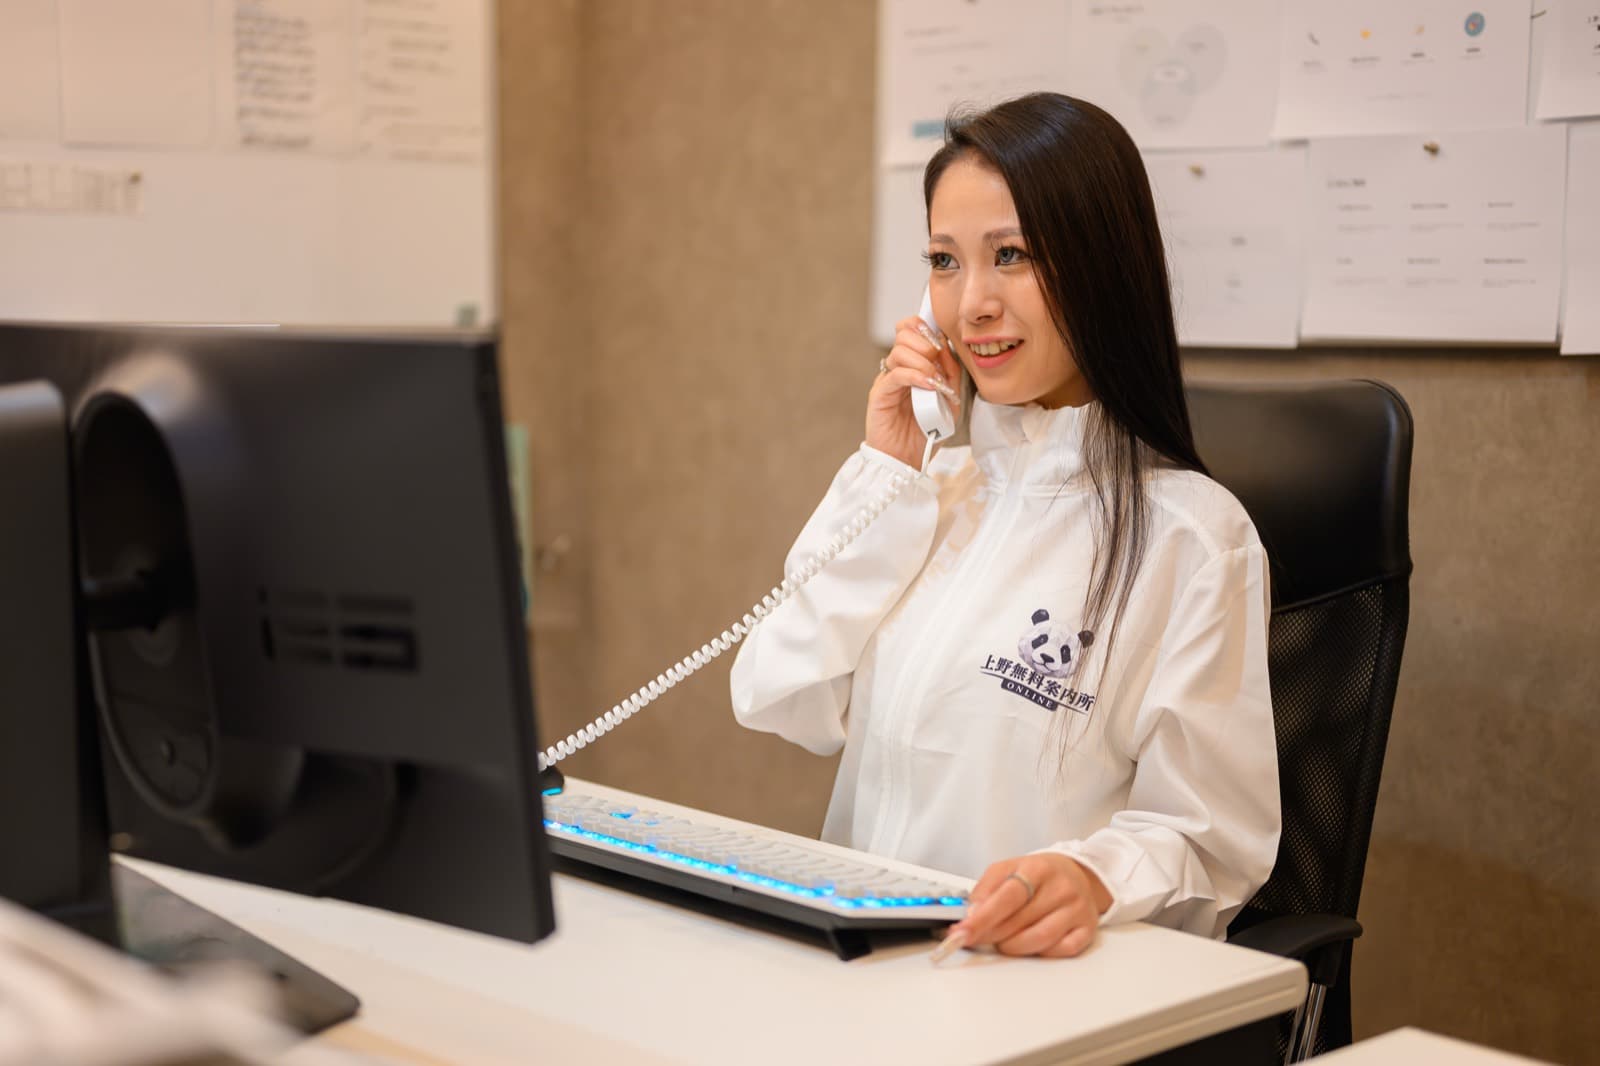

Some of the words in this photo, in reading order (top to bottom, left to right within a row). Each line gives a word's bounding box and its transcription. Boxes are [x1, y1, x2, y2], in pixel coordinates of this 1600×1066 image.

[980, 654, 1095, 711] 上野無料案内所
[1006, 681, 1054, 708] ONLINE
